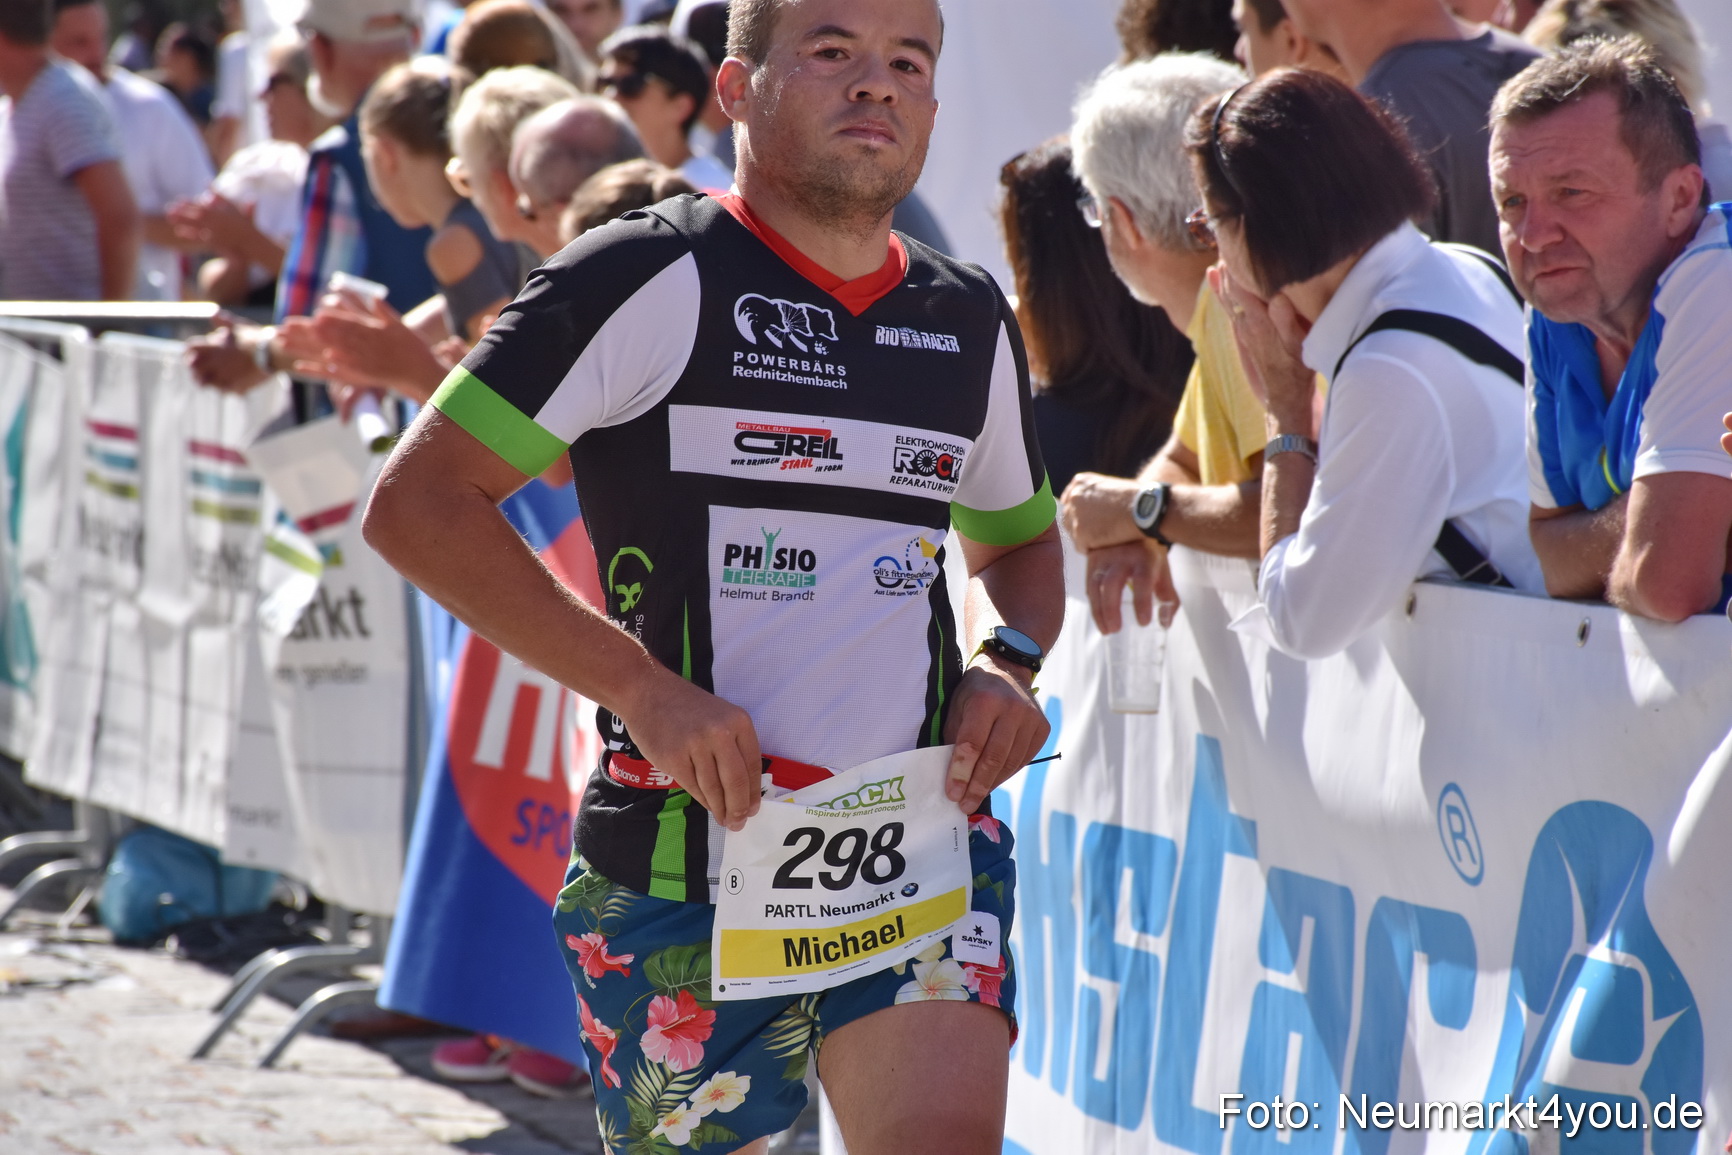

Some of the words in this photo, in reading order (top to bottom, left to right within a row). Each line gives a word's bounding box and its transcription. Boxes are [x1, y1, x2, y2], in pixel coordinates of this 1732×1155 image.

[920, 332, 960, 352] RACER
[733, 351, 847, 376] POWERBÄRS
[732, 365, 848, 390] Rednitzhembach
[737, 423, 791, 433] METALLBAU
[746, 457, 781, 466] BRINGEN
[780, 458, 814, 470] STAHL
[823, 464, 843, 472] FORM
[893, 446, 963, 484] ROCK
[728, 568, 811, 587] THERAPIE
[719, 587, 767, 601] Helmut
[771, 590, 815, 602] Brandt
[814, 776, 906, 810] OCK
[805, 806, 841, 818] inspired
[842, 808, 851, 819] by
[852, 808, 874, 817] smart
[874, 803, 906, 814] concepts
[772, 822, 906, 891] 298
[731, 875, 738, 888] B
[764, 904, 817, 918] PARTL
[819, 891, 895, 918] Neumarkt
[1002, 696, 1478, 1155] kstar
[782, 914, 906, 968] Michael
[961, 935, 993, 947] SAYSKY
